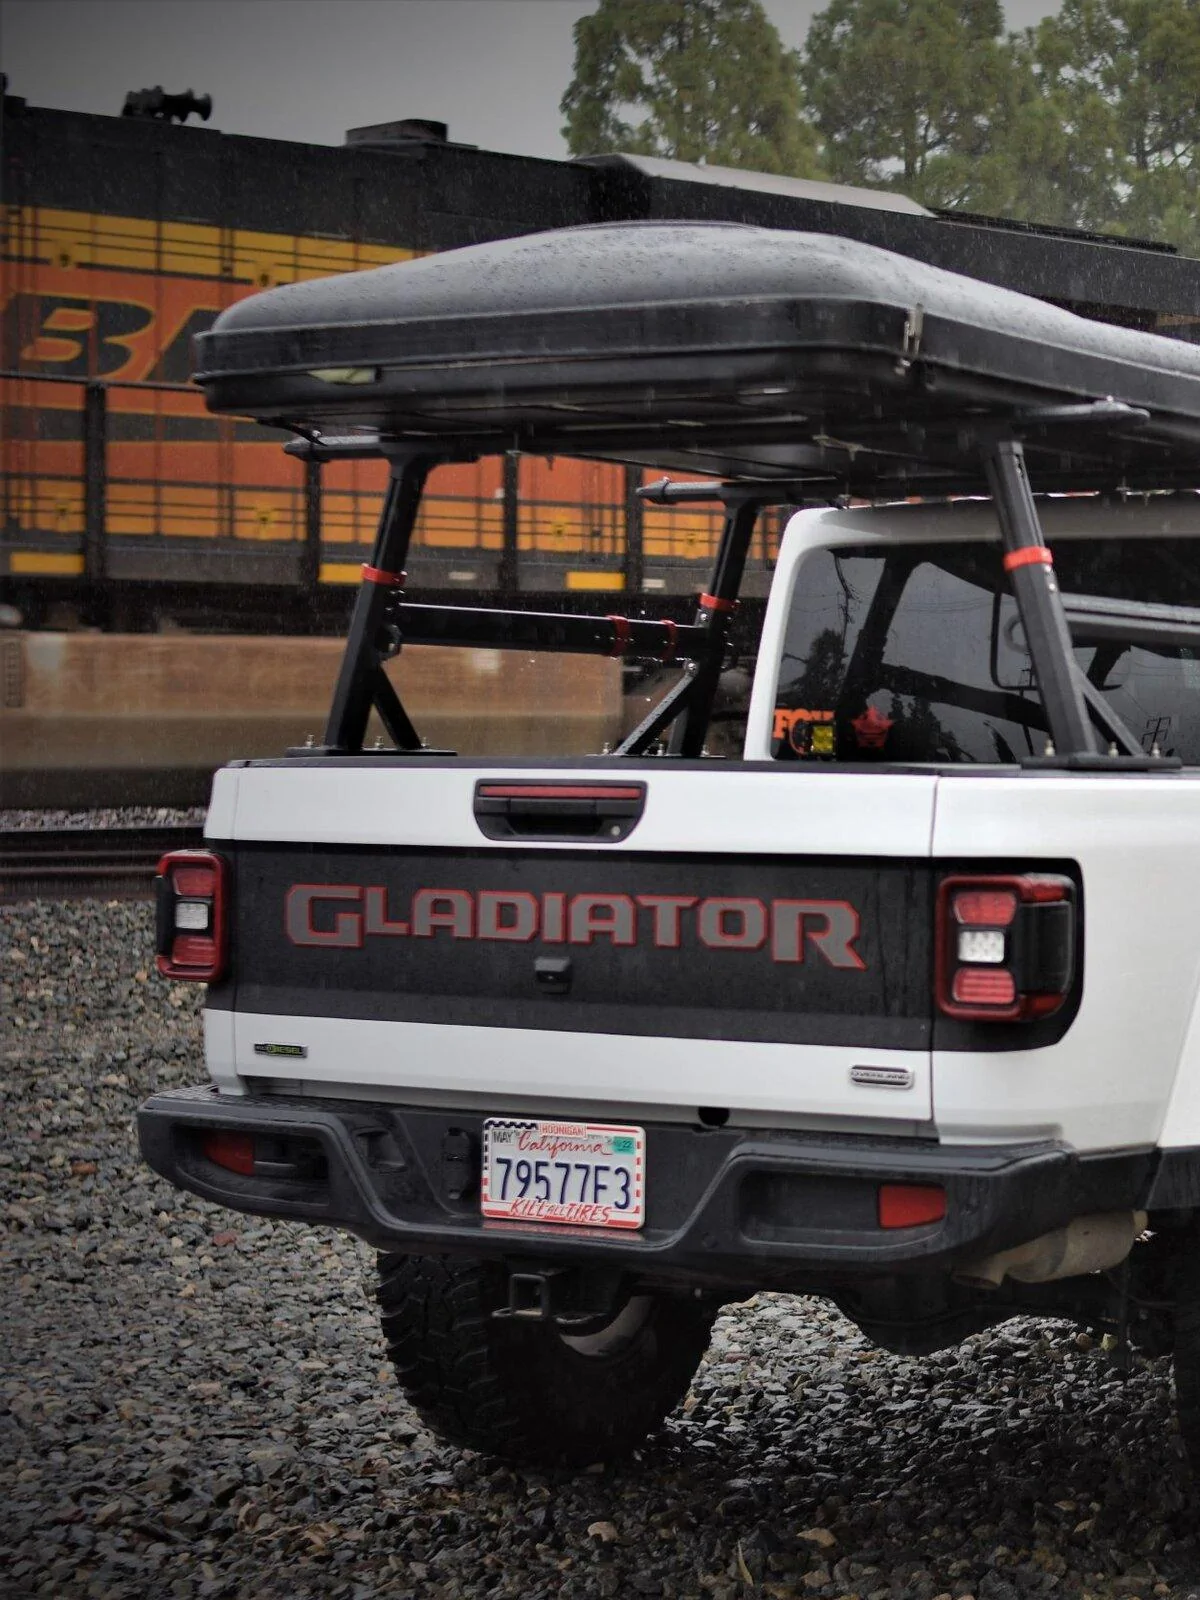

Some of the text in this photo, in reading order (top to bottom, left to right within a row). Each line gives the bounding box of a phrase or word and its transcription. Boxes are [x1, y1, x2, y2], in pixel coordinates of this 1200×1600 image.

[285, 883, 867, 970] GLADIATOR
[493, 1130, 512, 1143] MAY
[541, 1124, 584, 1136] HOONIGAN
[518, 1130, 613, 1158] California
[496, 1157, 631, 1210] 79577F3
[566, 1203, 612, 1223] TIRES
